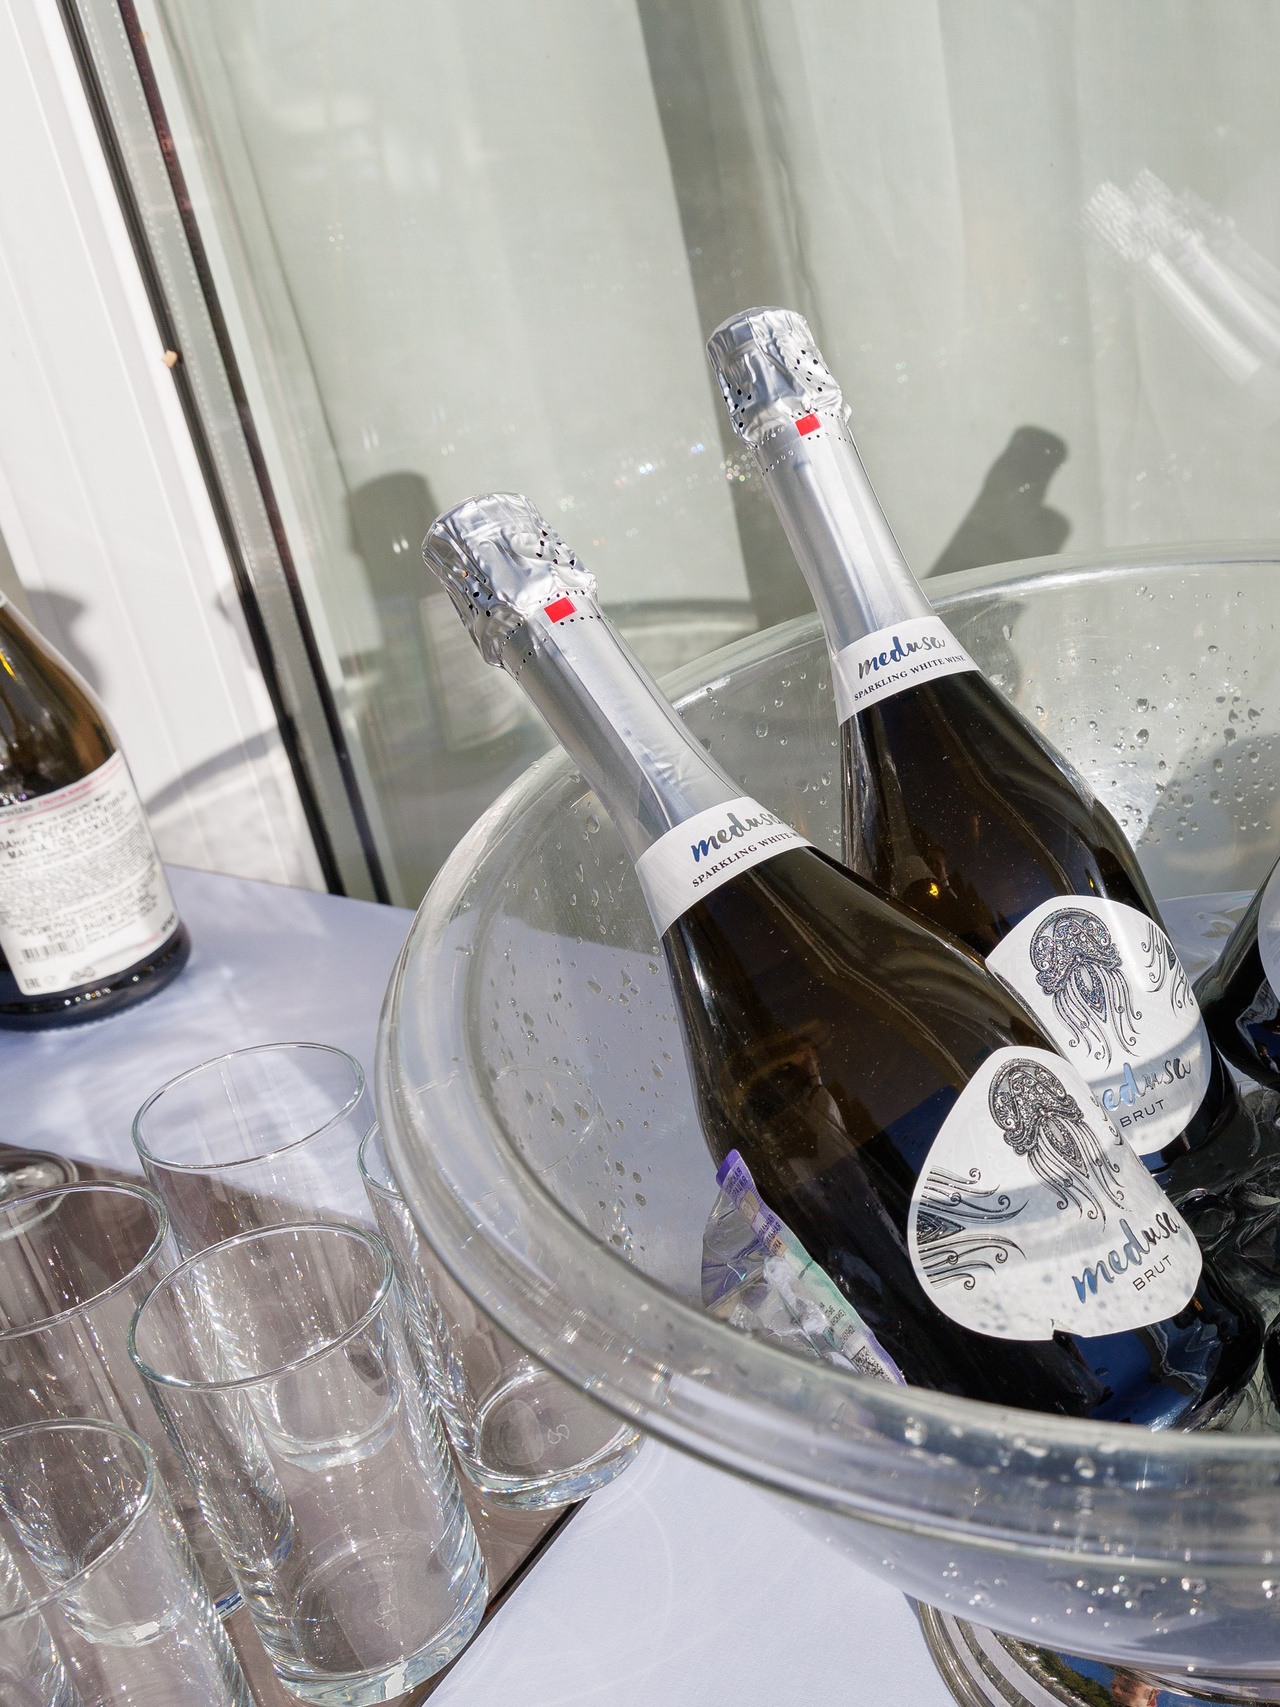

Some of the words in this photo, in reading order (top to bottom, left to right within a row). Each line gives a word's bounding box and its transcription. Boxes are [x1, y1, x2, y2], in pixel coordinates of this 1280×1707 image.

[854, 670, 908, 702] SPARKLING
[909, 657, 946, 675] WHITE
[944, 654, 966, 664] WINE
[857, 635, 946, 680] medusa
[690, 812, 785, 863] medusa
[691, 844, 758, 888] SPARKLING
[757, 832, 792, 847] WHITE
[1102, 1057, 1192, 1112] edusa
[1119, 1099, 1164, 1128] BRUT
[1071, 1211, 1181, 1304] medusa
[1131, 1254, 1174, 1291] BRUT
